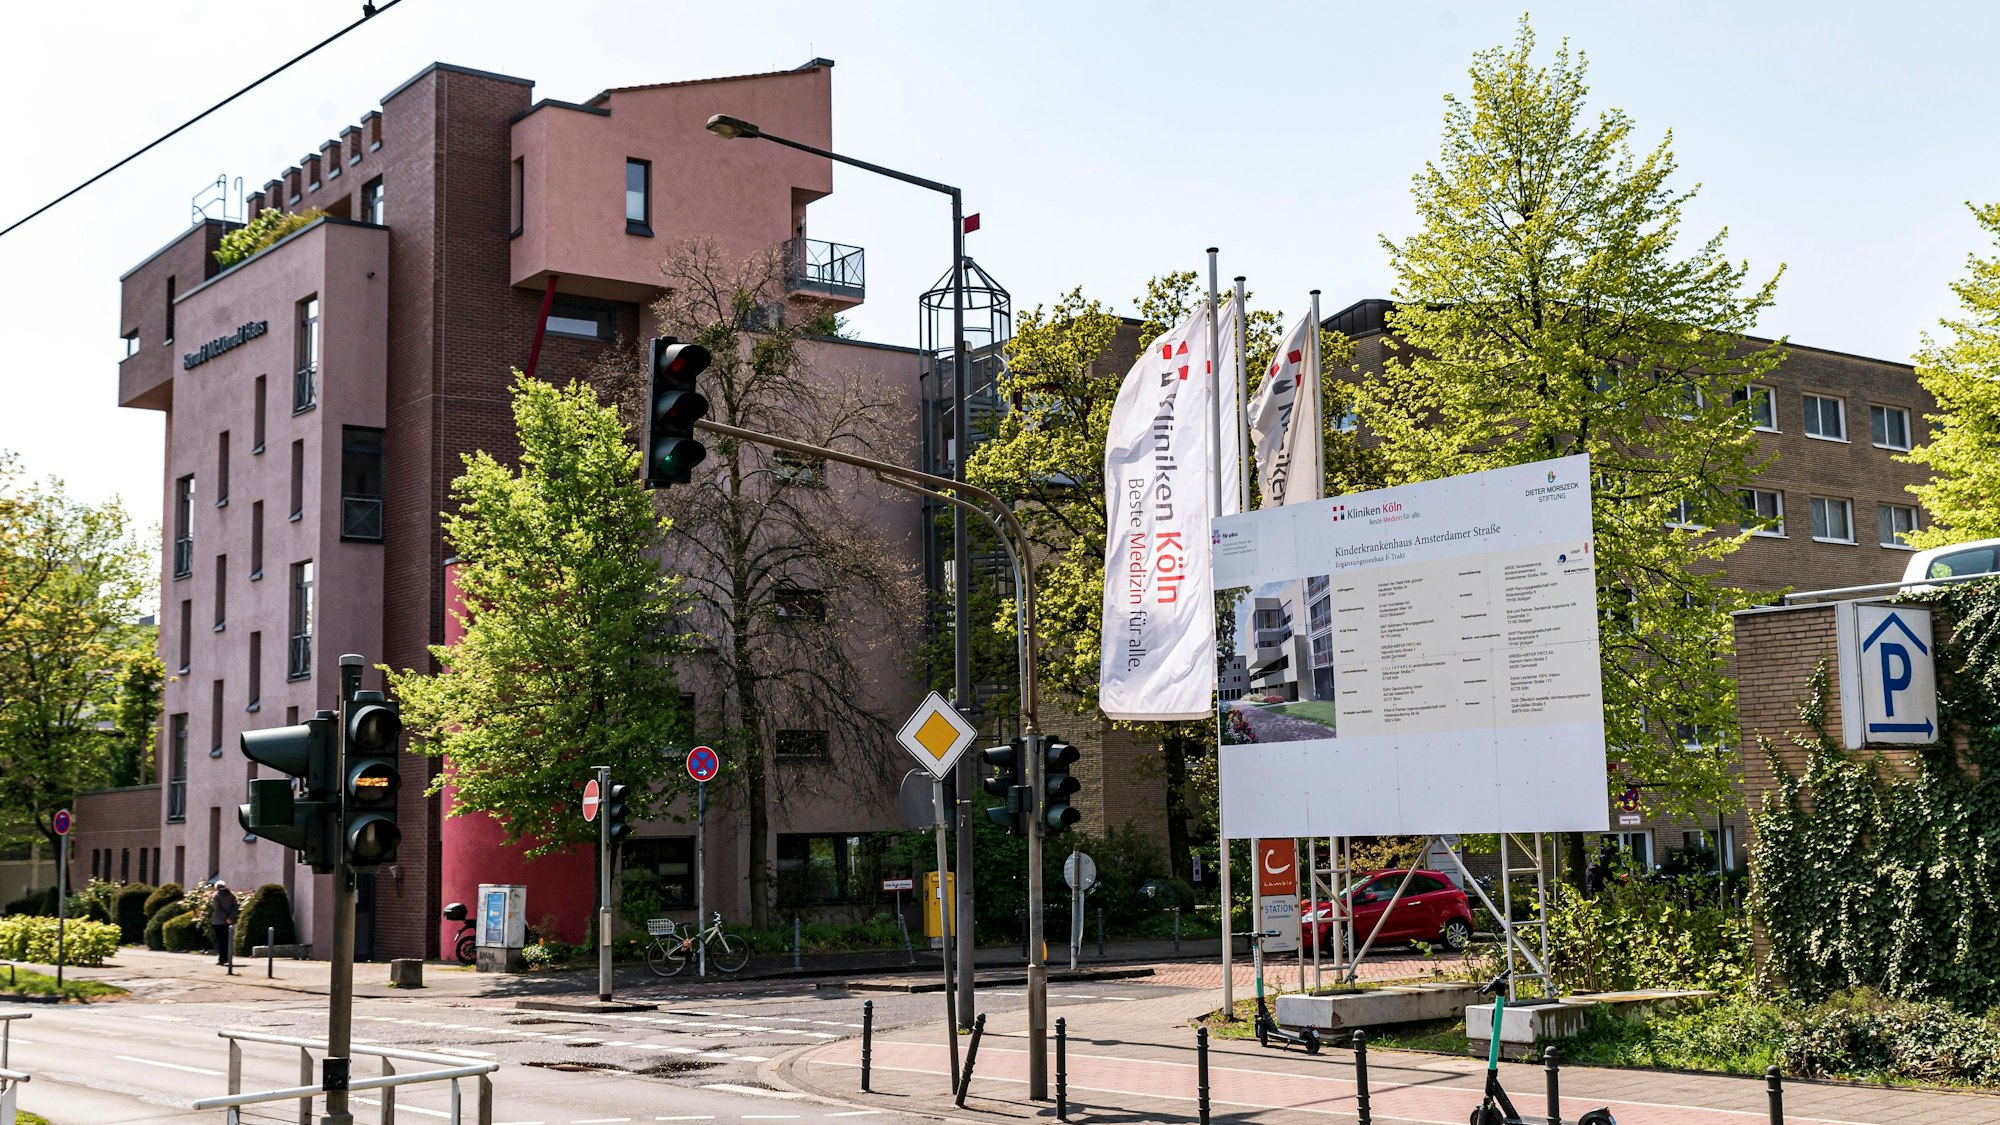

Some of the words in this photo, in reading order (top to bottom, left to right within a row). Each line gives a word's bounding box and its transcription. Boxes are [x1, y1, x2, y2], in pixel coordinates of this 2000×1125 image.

[1154, 393, 1178, 521] Kliniken
[1128, 478, 1144, 527] Beste
[1526, 488, 1545, 496] DIETER
[1547, 482, 1579, 492] MORSZECK
[1539, 493, 1566, 502] STIFTUNG
[1348, 506, 1380, 519] Kliniken
[1383, 502, 1402, 513] Köln
[1383, 515, 1402, 523] Medizin
[1335, 539, 1412, 557] Kinderkrankenhaus
[1415, 528, 1471, 545] Amsterdamer
[1473, 523, 1501, 536] Straße
[1129, 533, 1147, 605] Medizin
[1156, 531, 1185, 603] Köln
[1336, 556, 1384, 568] Ergänzungsneubau
[1129, 609, 1147, 635] für
[1128, 639, 1146, 672] alle.
[1880, 642, 1912, 717] P
[1265, 904, 1293, 913] STATION
